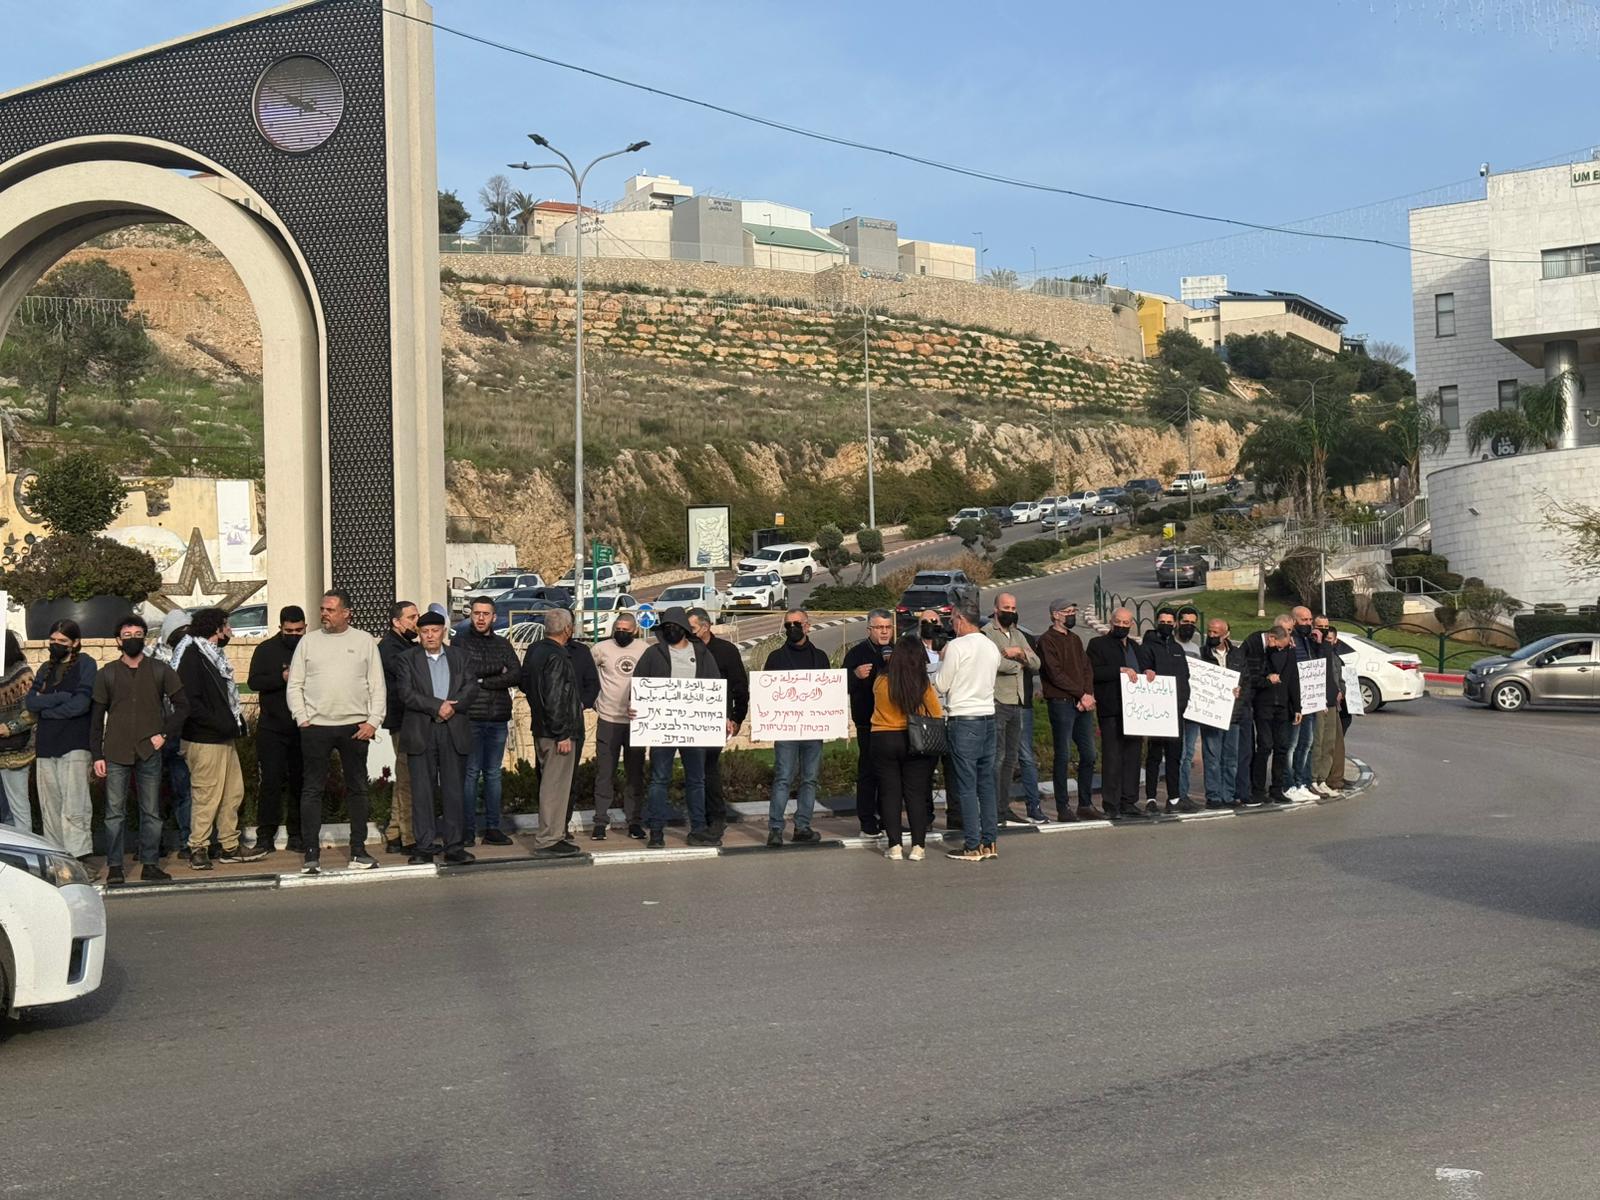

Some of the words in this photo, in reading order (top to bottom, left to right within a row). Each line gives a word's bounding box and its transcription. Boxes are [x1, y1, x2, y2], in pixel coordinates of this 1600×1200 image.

[1573, 171, 1590, 183] UM
[815, 672, 842, 686] الشرطة
[635, 707, 661, 721] את
[665, 708, 687, 718] נחייב
[688, 711, 723, 721] באחדות
[757, 703, 770, 718] על
[770, 709, 804, 723] אחראית
[810, 709, 845, 717] המשטרה
[632, 722, 649, 736] את
[650, 718, 681, 731] לבצע
[682, 722, 721, 732] המשטרה
[753, 723, 796, 734] והבטיחות
[800, 724, 830, 737] הבטחון
[661, 734, 695, 744] חובתה
